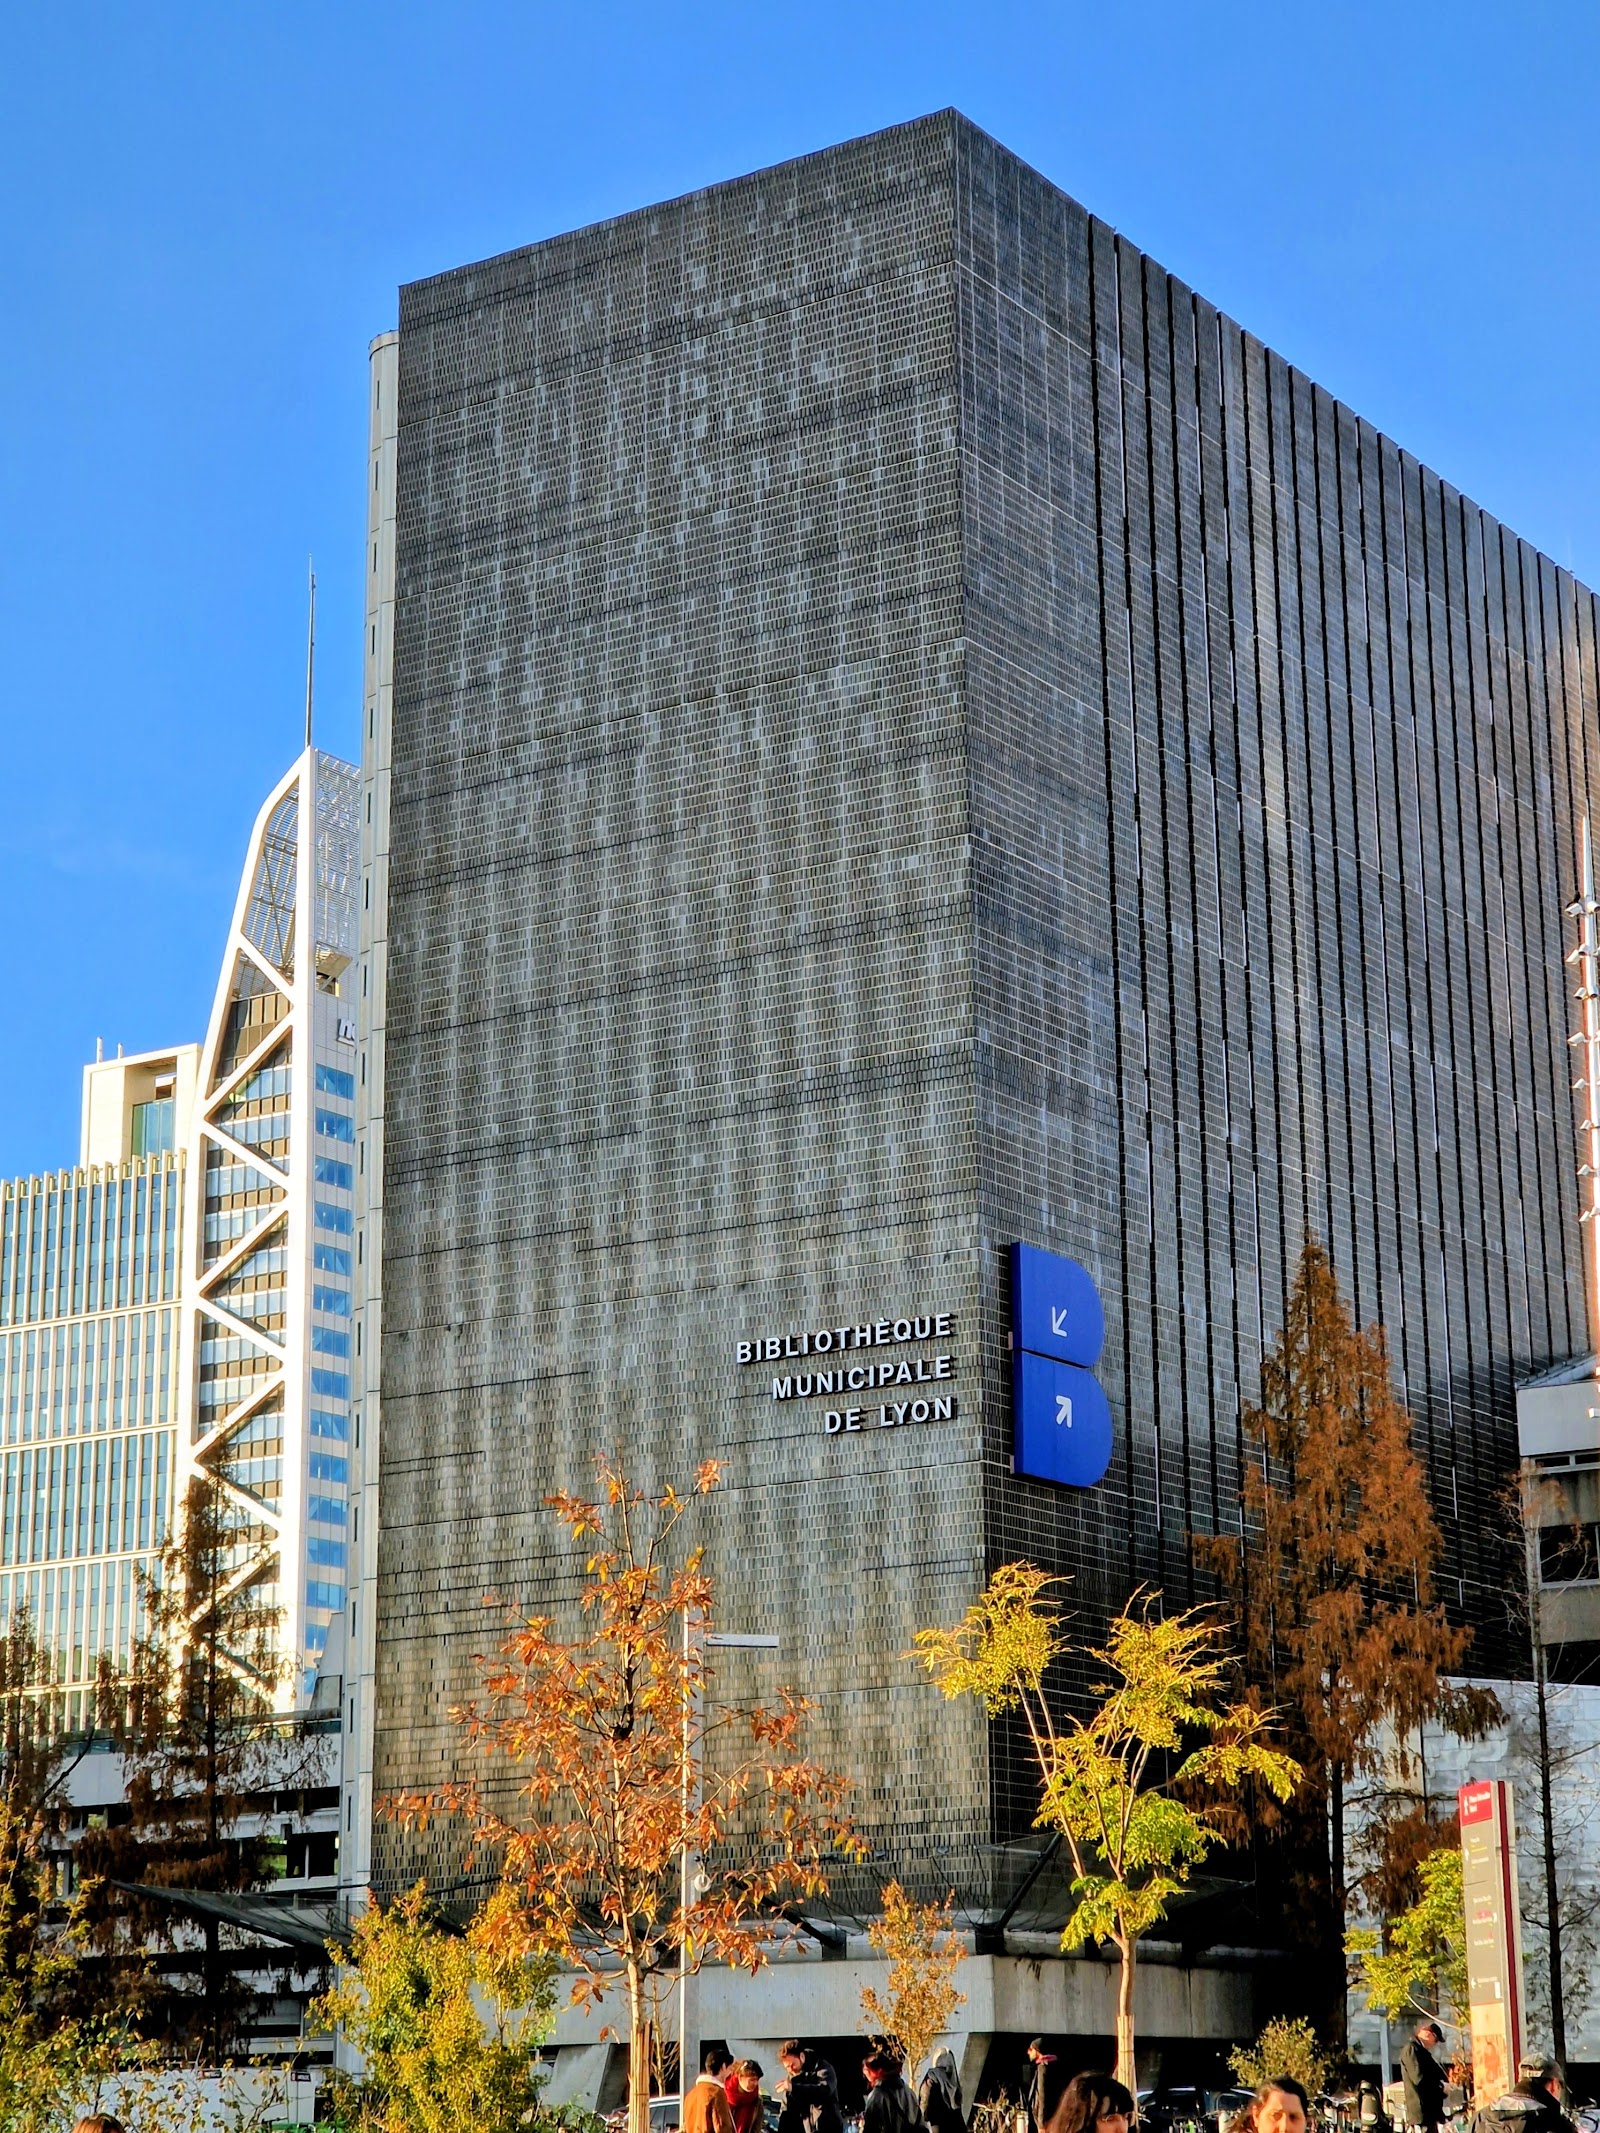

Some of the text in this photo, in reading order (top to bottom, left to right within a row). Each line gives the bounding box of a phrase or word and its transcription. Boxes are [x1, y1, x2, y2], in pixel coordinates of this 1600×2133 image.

[736, 1313, 951, 1364] BIBLIOTHÈQUE
[772, 1355, 951, 1400] MUNICIPALE
[825, 1397, 952, 1434] DE LYON
